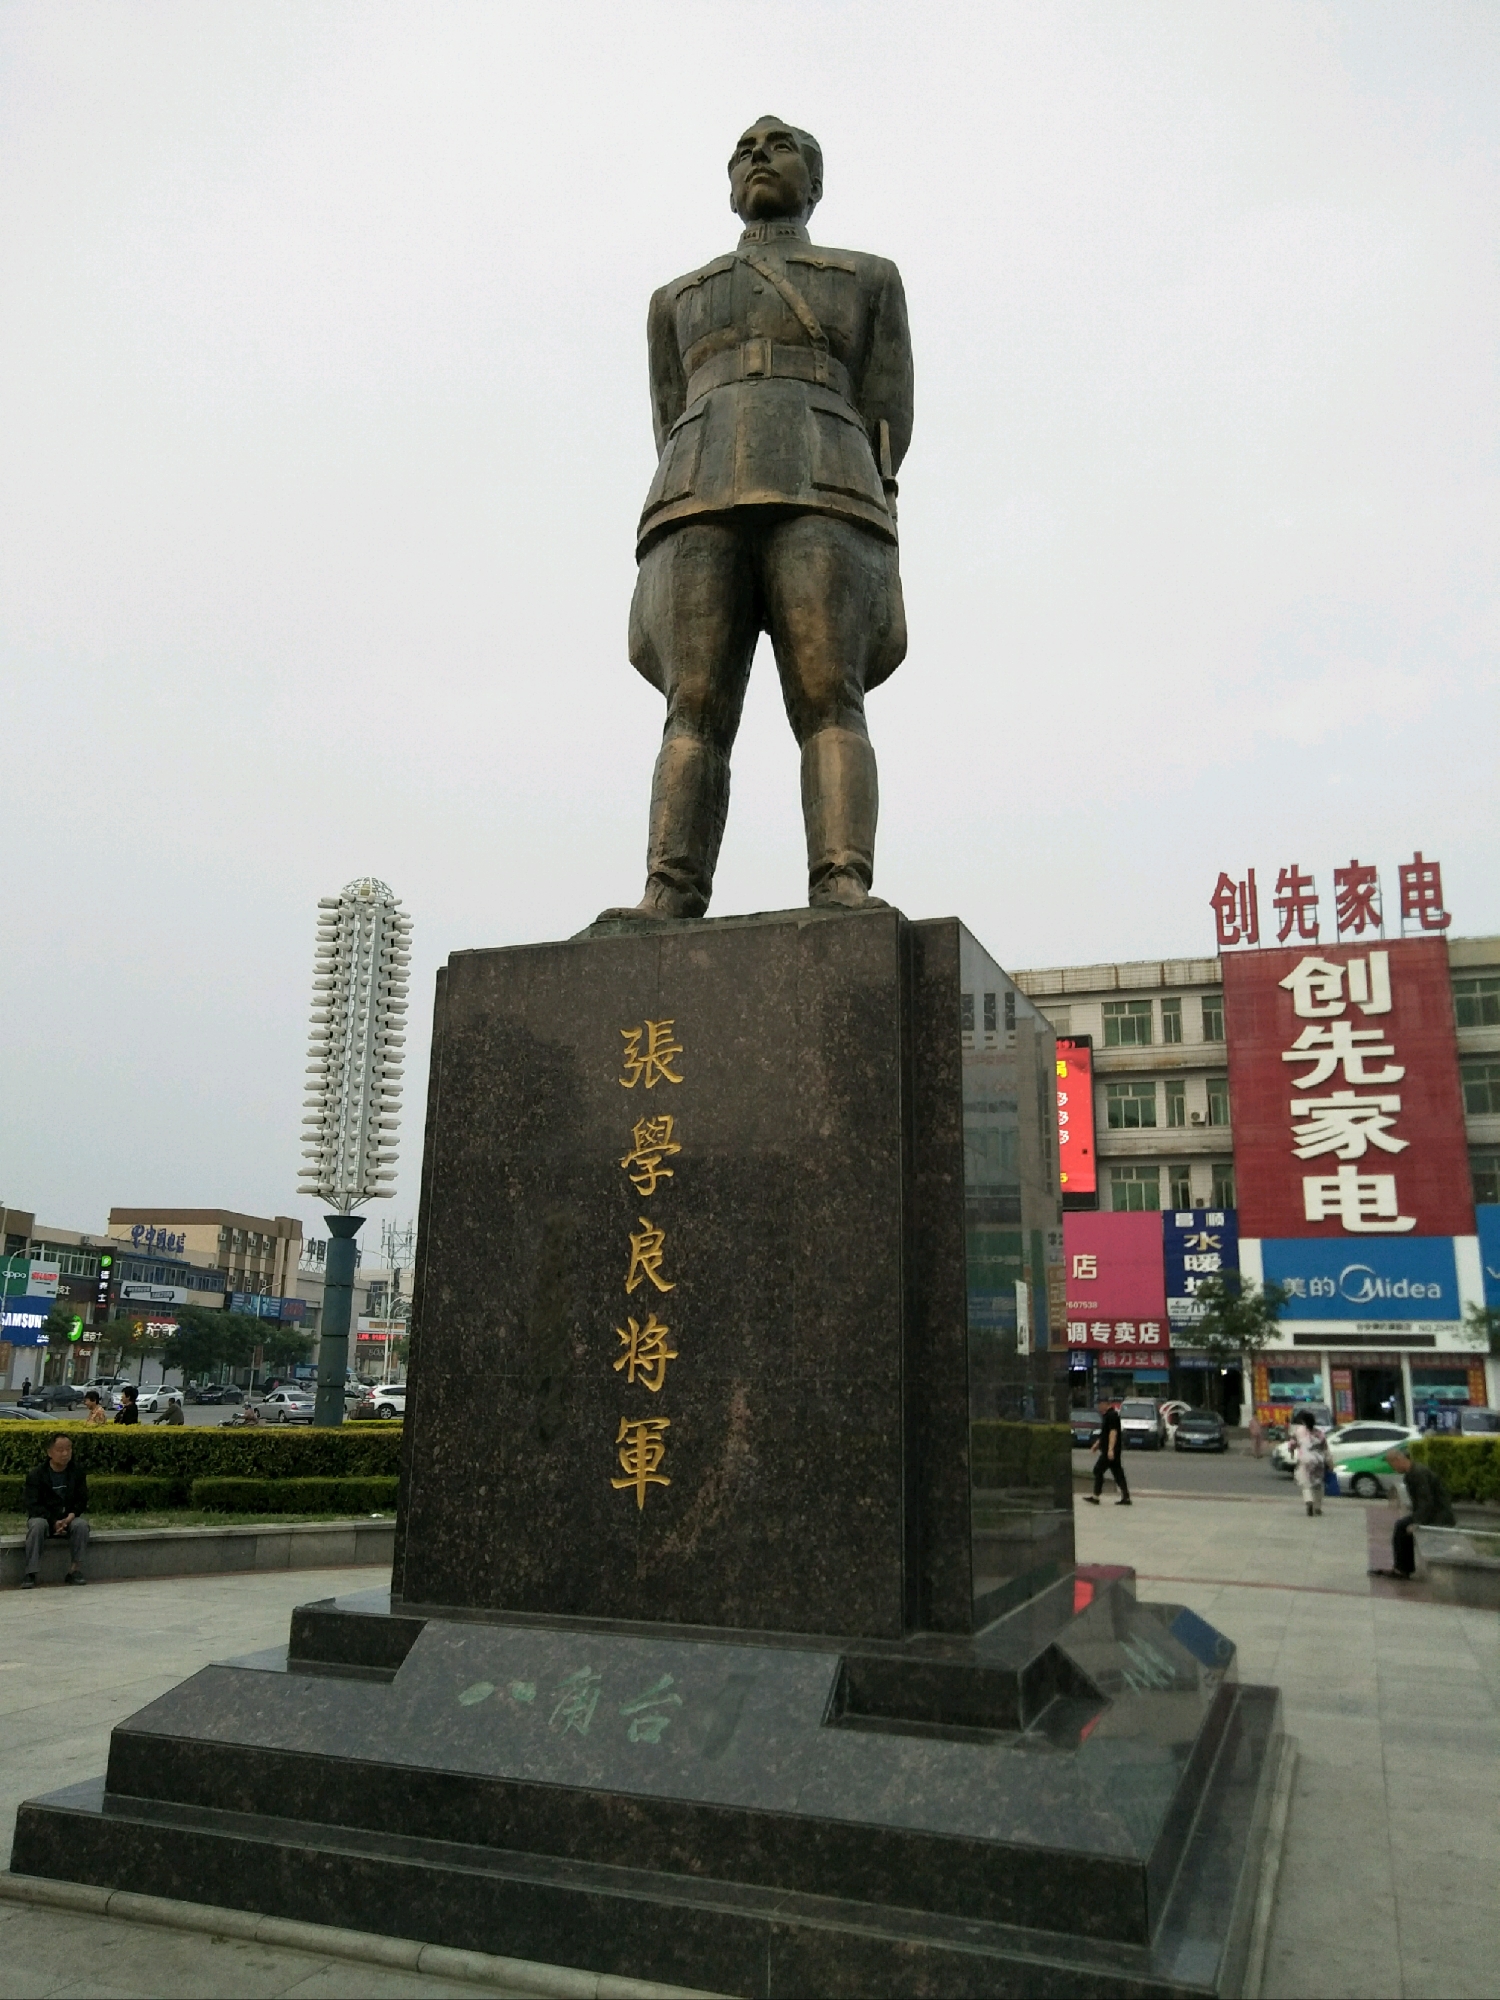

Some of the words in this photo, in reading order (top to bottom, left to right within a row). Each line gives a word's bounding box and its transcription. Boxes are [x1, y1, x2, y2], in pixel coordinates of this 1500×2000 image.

[1209, 851, 1452, 945] 创先家电
[1277, 950, 1417, 1233] 创先家电
[1072, 1254, 1098, 1280] 店
[1283, 1276, 1336, 1299] 美的
[1358, 1276, 1442, 1299] Midea
[1066, 1321, 1161, 1344] 调专卖店
